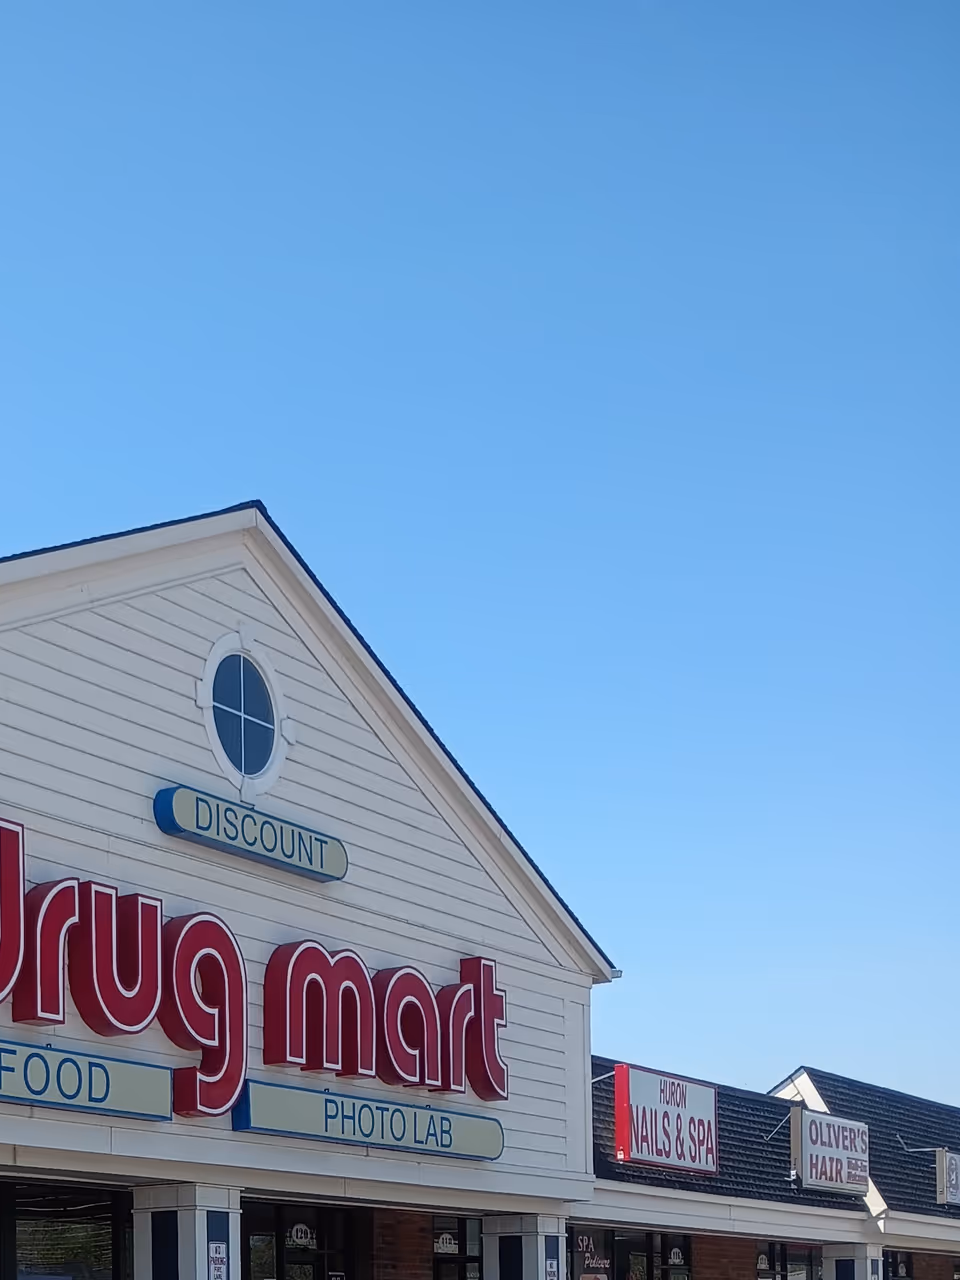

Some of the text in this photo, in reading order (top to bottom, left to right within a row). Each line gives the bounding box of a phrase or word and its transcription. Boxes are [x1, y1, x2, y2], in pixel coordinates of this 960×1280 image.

[195, 796, 328, 870] DISCOUNT
[263, 940, 508, 1100] mart
[660, 1079, 687, 1109] HURON
[324, 1099, 453, 1149] PHOTO LAB
[630, 1104, 715, 1166] NAILS & SPA
[809, 1119, 868, 1154] OLIVER'S
[809, 1153, 844, 1184] HAIR
[295, 1227, 309, 1239] 120
[578, 1236, 594, 1252] SPA
[584, 1253, 611, 1269] Pedicure
